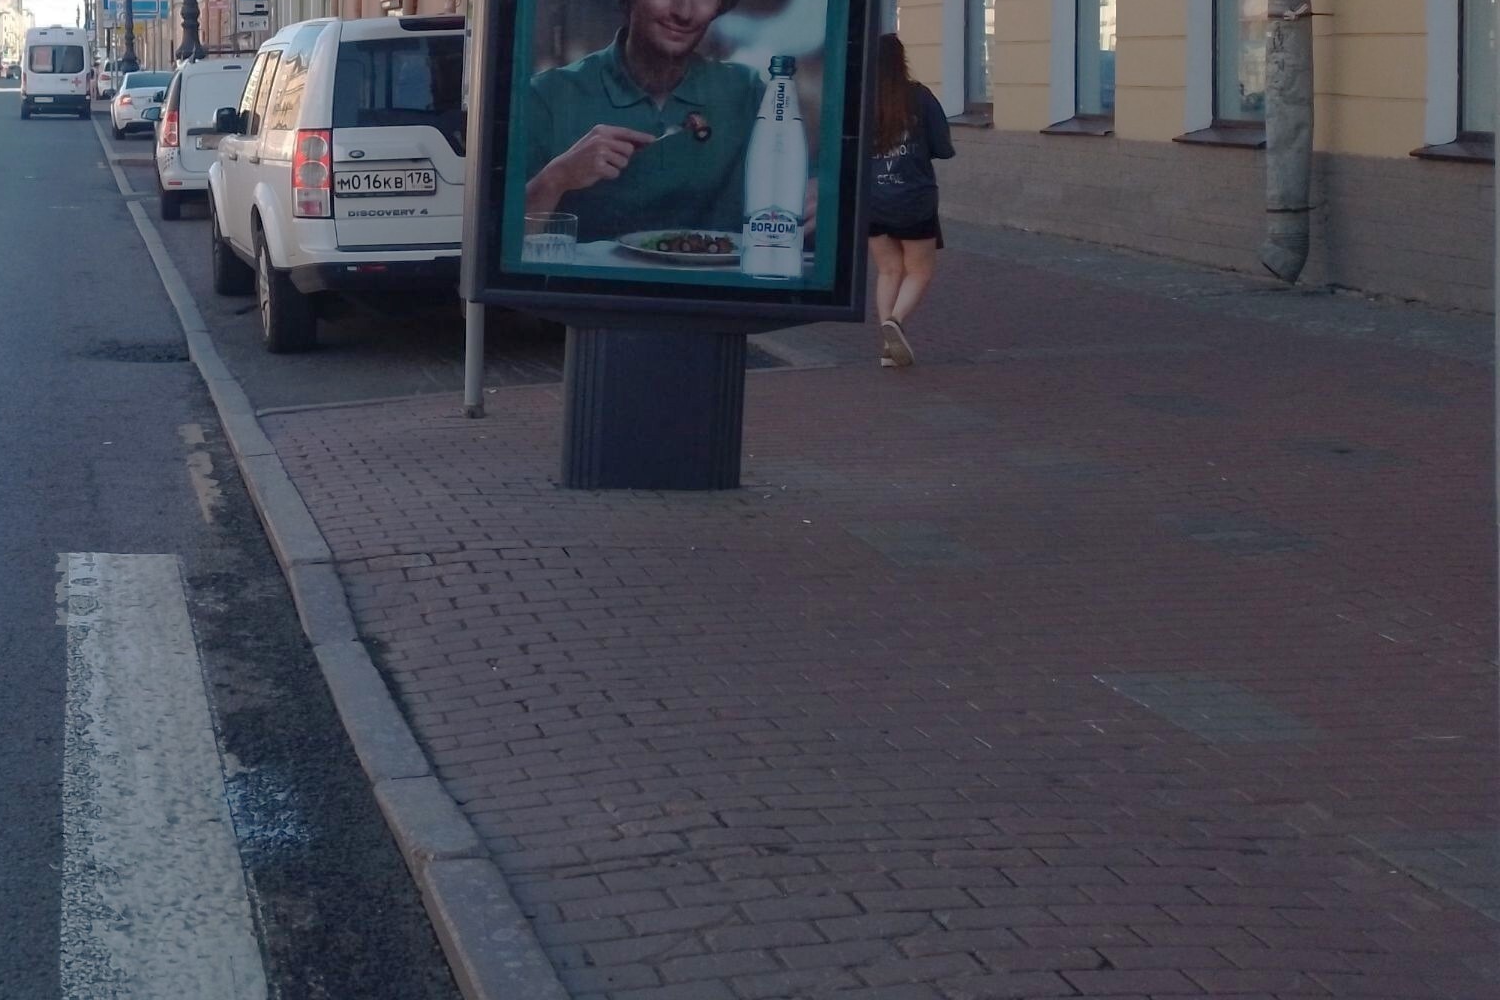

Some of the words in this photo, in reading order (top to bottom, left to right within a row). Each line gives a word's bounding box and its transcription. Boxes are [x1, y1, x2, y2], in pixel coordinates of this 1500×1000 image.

[775, 82, 785, 121] BORJOMI
[407, 172, 430, 184] 178
[348, 208, 416, 217] DISCOVERY
[751, 222, 796, 233] BORJOMI
